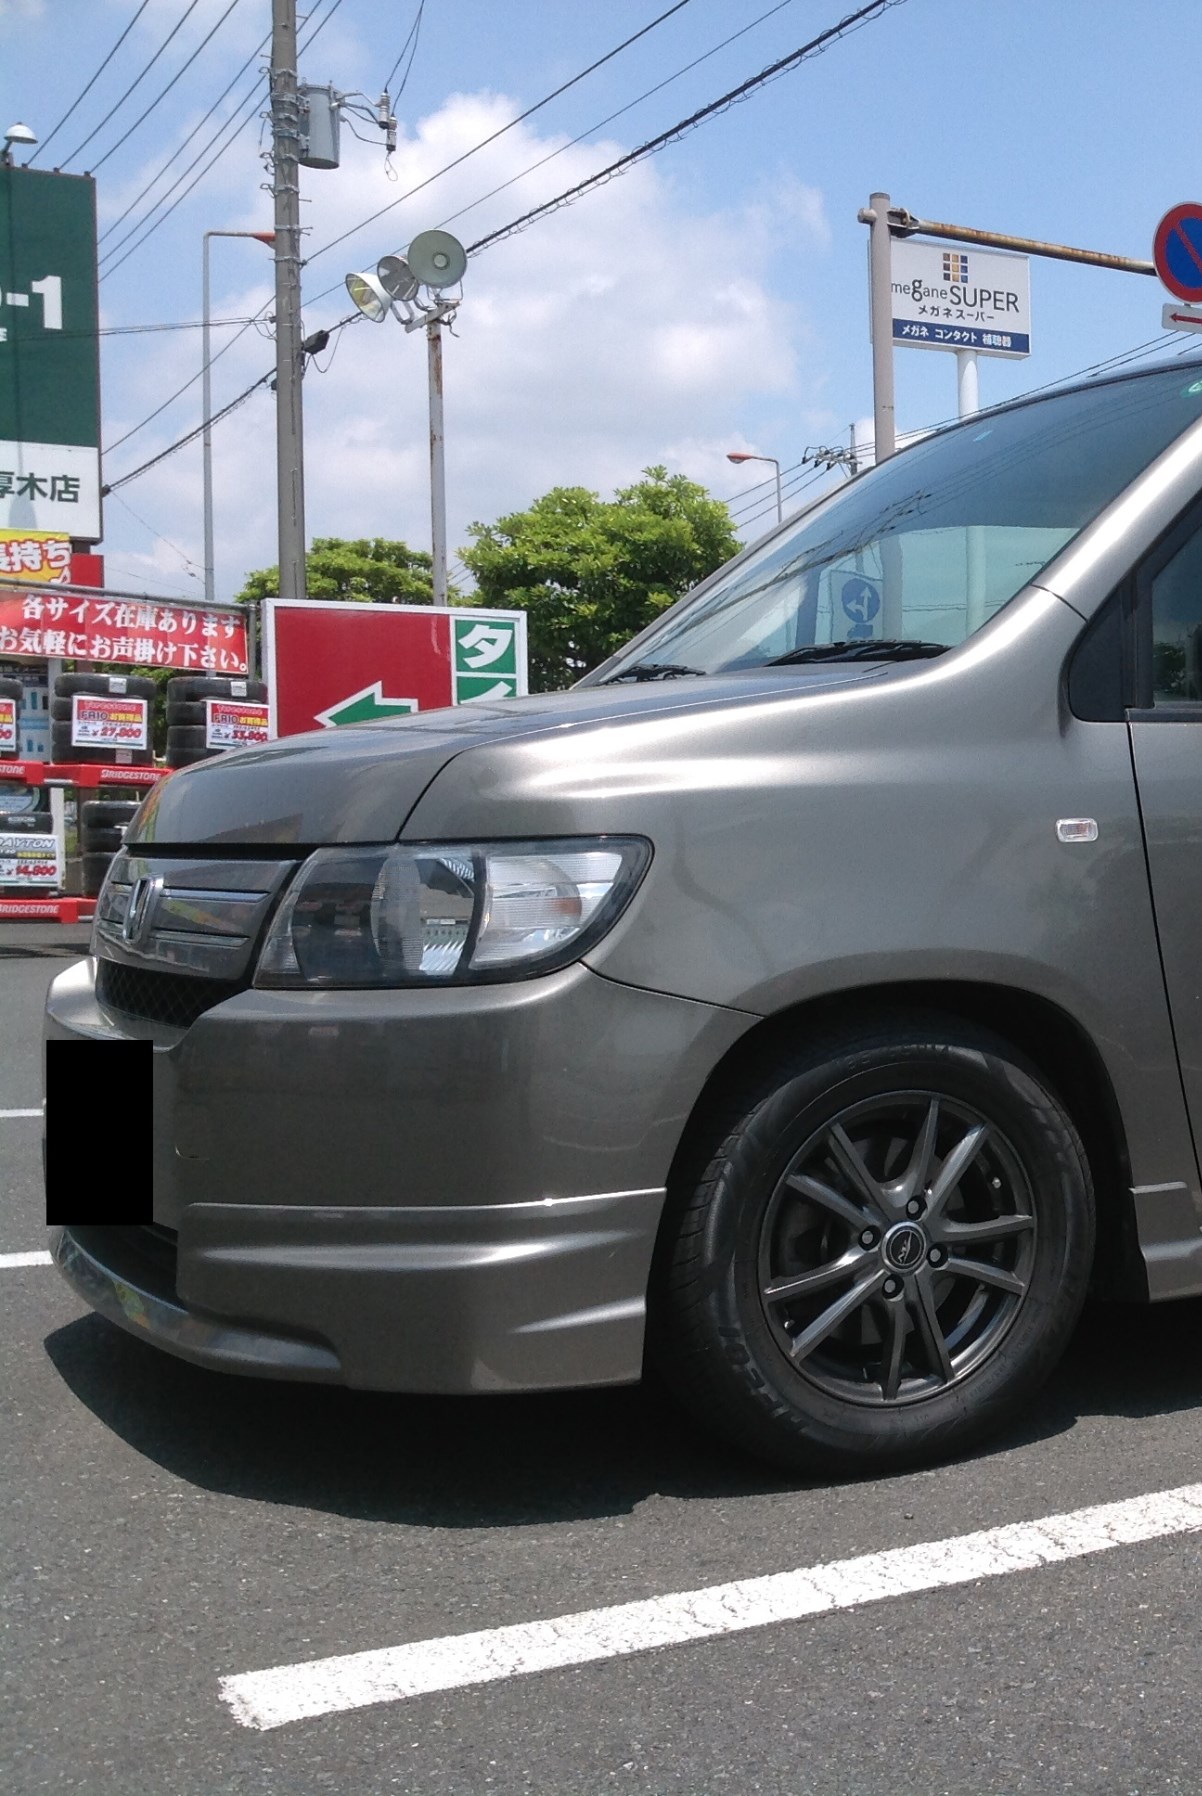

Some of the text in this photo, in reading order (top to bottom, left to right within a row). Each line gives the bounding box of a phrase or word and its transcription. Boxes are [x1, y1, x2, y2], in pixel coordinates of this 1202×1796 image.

[0, 275, 62, 330] -1
[918, 305, 995, 322] メガネスーパー
[902, 324, 929, 337] メガネ
[935, 328, 977, 343] コンタクト
[21, 594, 241, 638] 各サイズ在庫あります
[0, 625, 248, 672] お気軽にお声掛け下さい。
[101, 769, 161, 781] BRIDGESTONE
